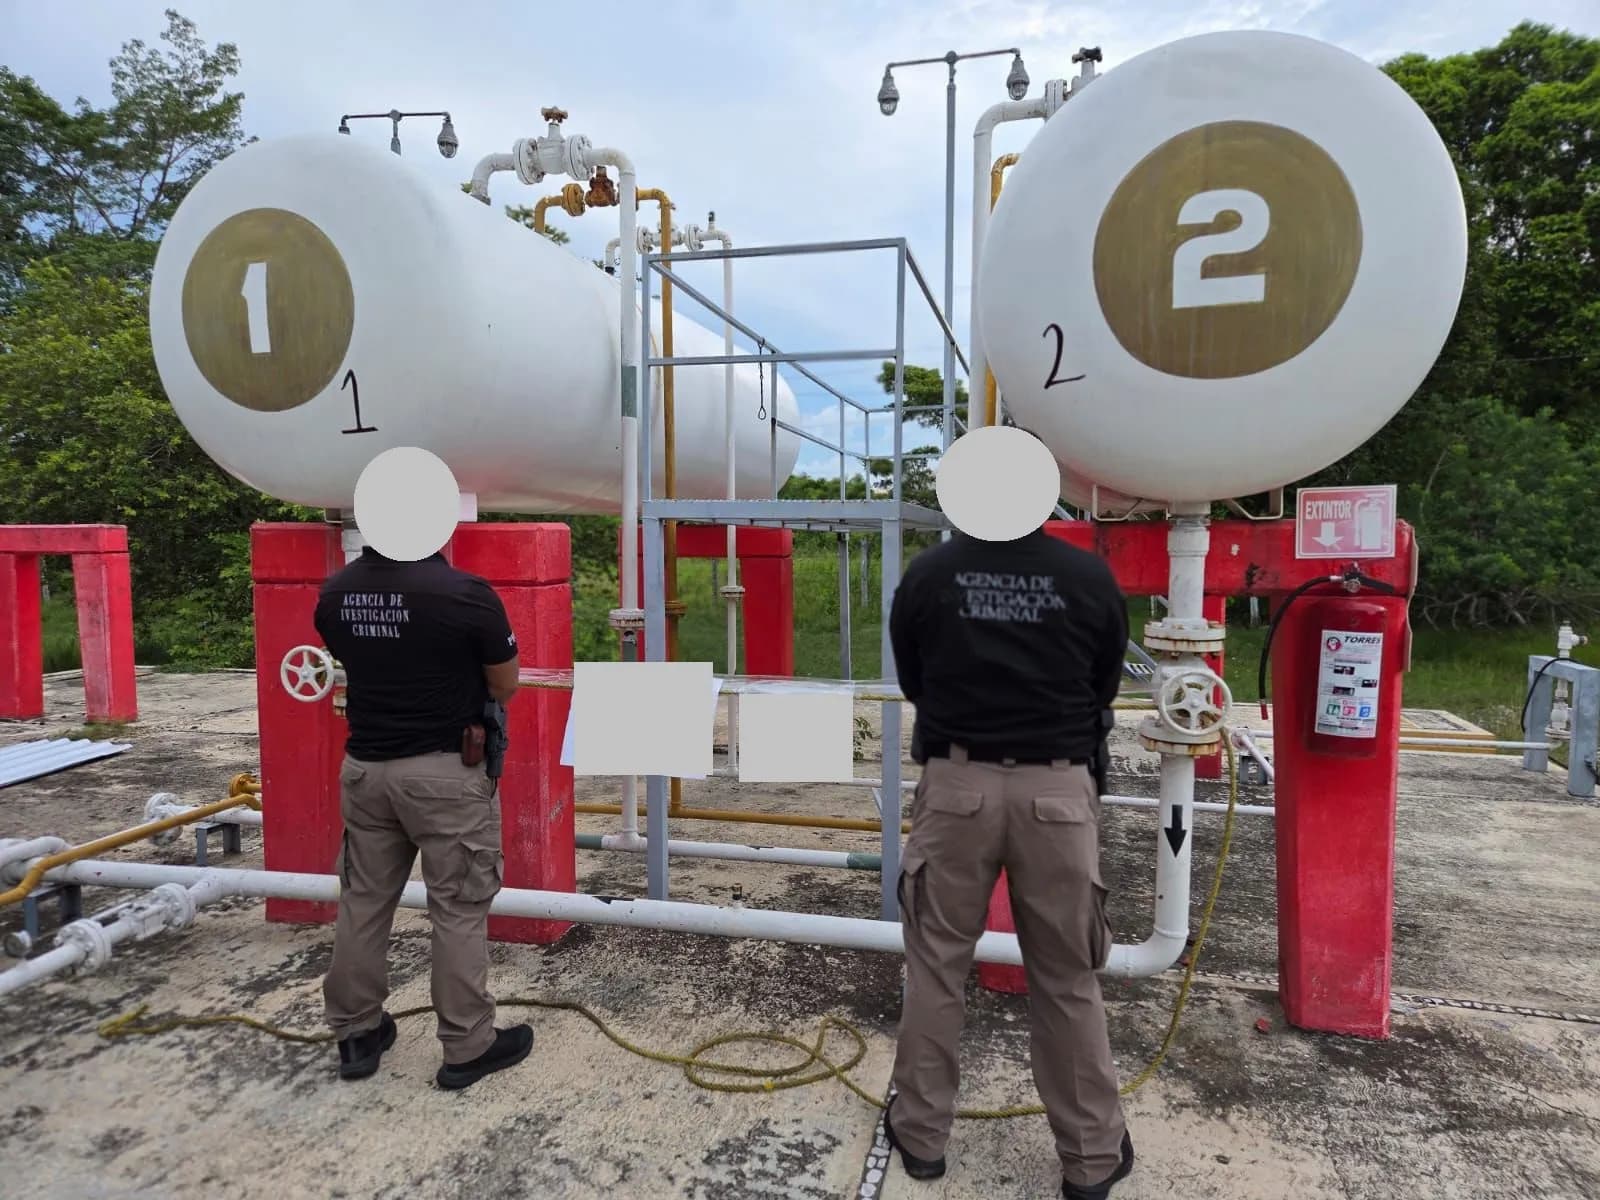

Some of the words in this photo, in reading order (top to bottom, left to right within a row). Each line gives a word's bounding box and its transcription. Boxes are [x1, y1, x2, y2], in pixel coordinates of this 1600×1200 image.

[1172, 188, 1270, 309] 2
[240, 262, 271, 354] 1
[1043, 323, 1086, 390] 2
[341, 369, 379, 434] 1
[1305, 500, 1352, 520] EXTINTOR
[955, 572, 1028, 590] AGENCIA
[1030, 575, 1055, 591] DE
[342, 593, 385, 607] AGENCIA
[390, 593, 404, 607] DE
[962, 588, 1067, 609] ESTIGACION
[957, 604, 1043, 623] CRIMINAL
[352, 624, 401, 638] CRIMINAL
